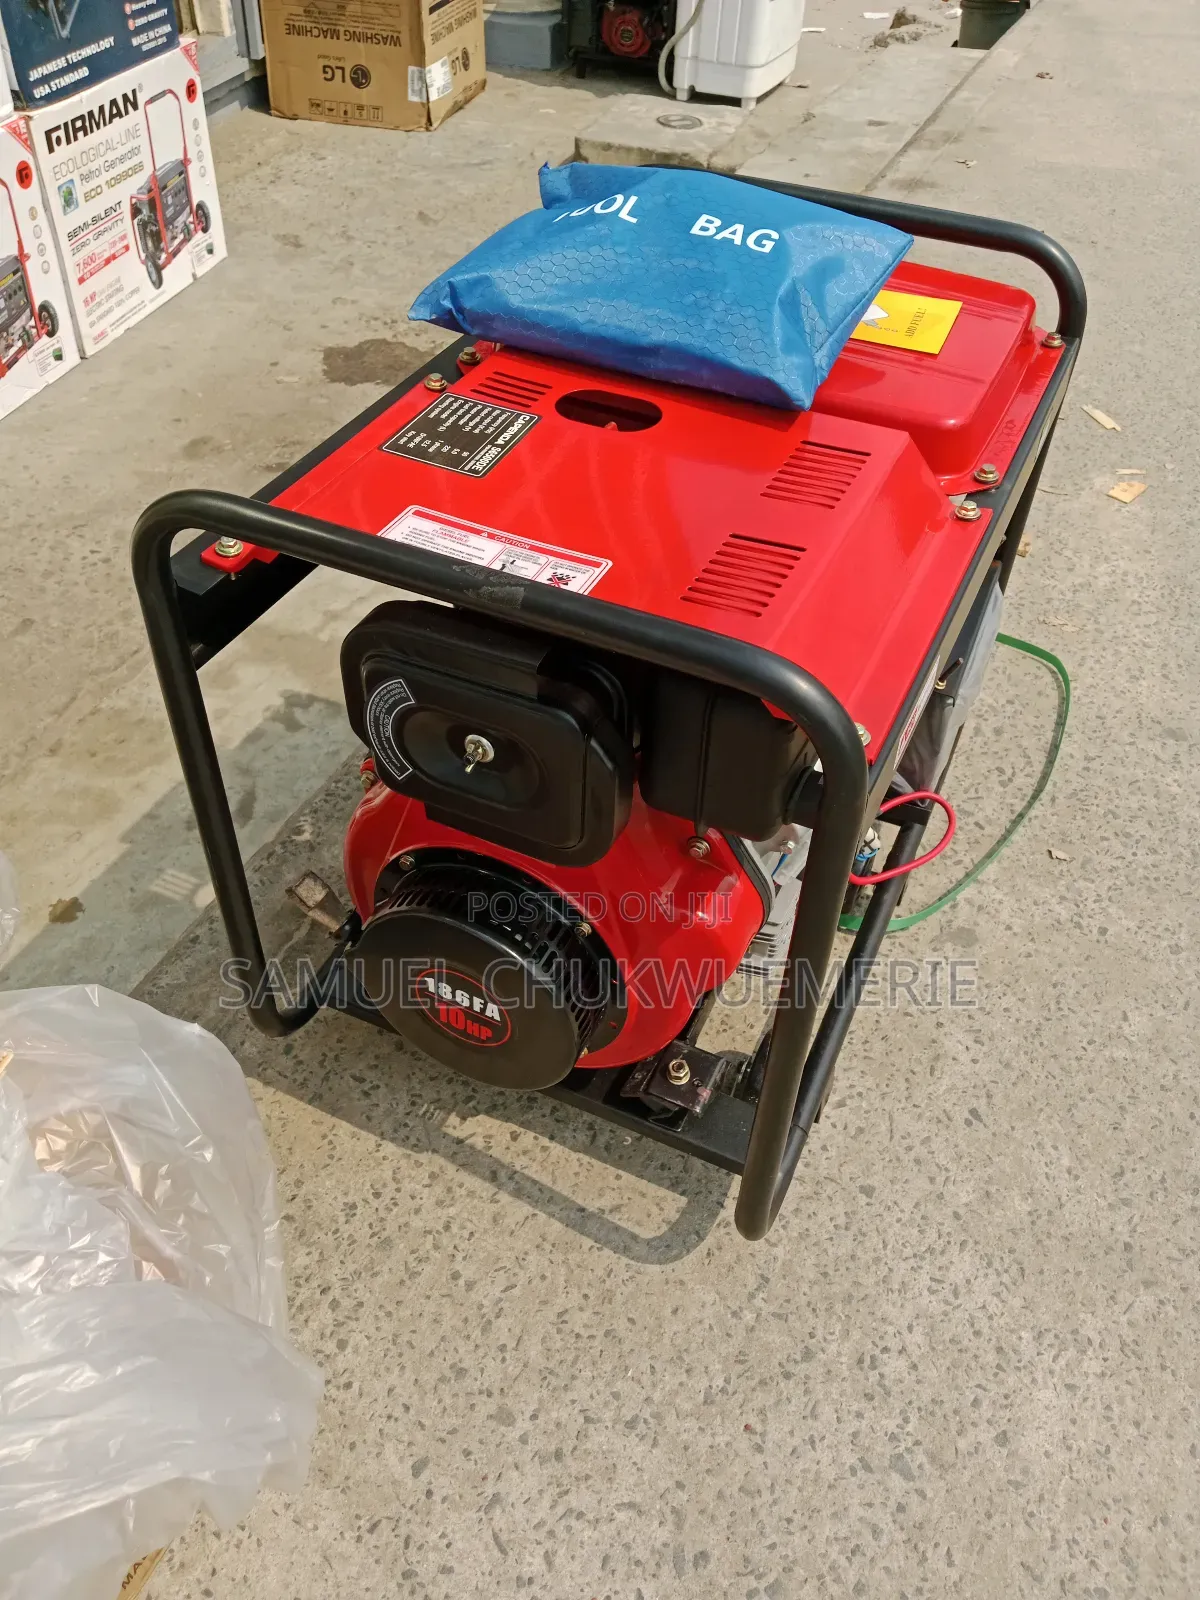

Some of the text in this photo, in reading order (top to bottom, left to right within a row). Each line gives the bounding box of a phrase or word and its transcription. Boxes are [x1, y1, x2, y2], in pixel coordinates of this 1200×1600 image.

[284, 23, 341, 41] MACHINE
[344, 30, 402, 47] WASHING
[28, 57, 68, 82] JAPANESE
[66, 36, 115, 64] TECHNOLOGY
[323, 64, 346, 83] LG
[33, 66, 90, 99] USA STANDARD
[44, 88, 139, 154] FIRMAN
[53, 123, 141, 181] ECOLOGICAL-LINE
[80, 145, 142, 186] Petrol Generator
[84, 184, 103, 203] ECO
[67, 200, 122, 241] SEMI-SILENT
[71, 238, 91, 256] ZERO
[92, 216, 124, 241] GRAVITY
[690, 214, 780, 253] BAG
[494, 414, 530, 445] CAPENDA
[494, 535, 531, 550] CAUTION
[424, 977, 501, 1021] 186FA
[435, 1002, 492, 1040] 10HP
